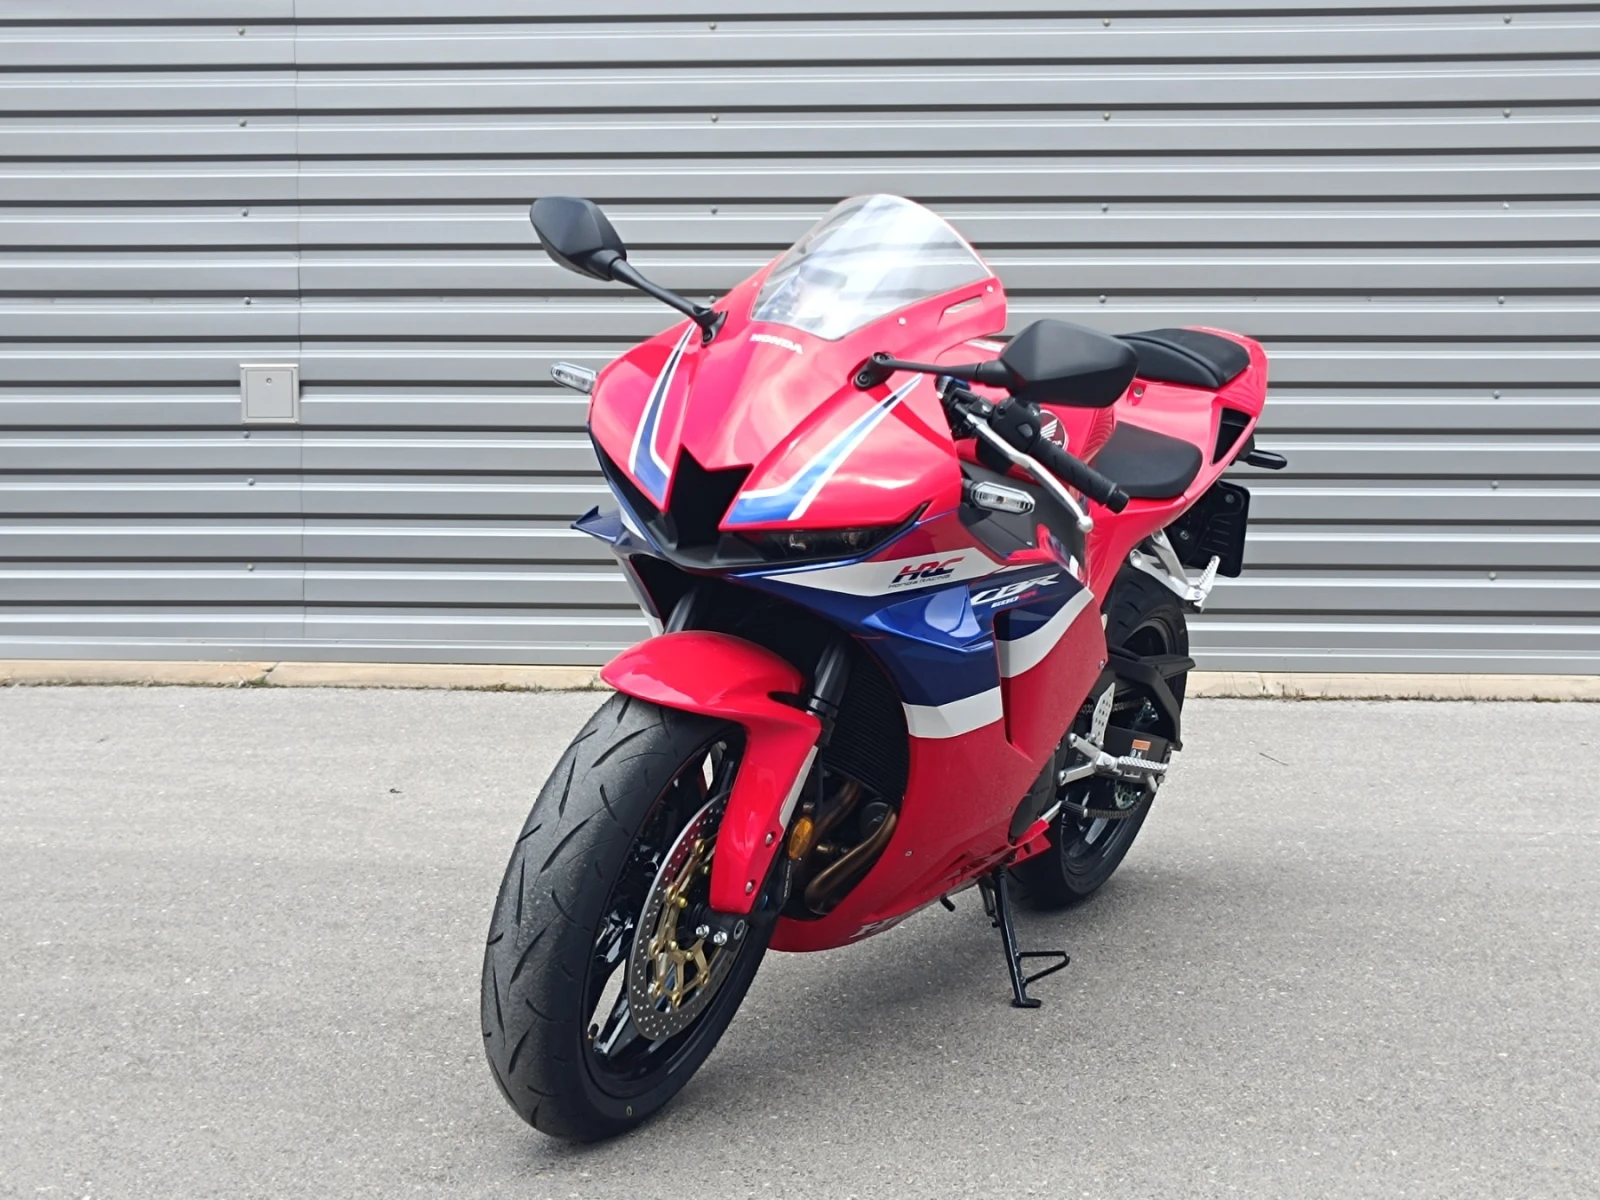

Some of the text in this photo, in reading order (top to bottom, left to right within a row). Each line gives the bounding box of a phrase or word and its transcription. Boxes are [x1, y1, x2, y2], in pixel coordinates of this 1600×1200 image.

[749, 333, 803, 354] HONDA
[892, 556, 966, 583] HRC
[919, 574, 951, 584] RACING
[970, 572, 1060, 606] CBR
